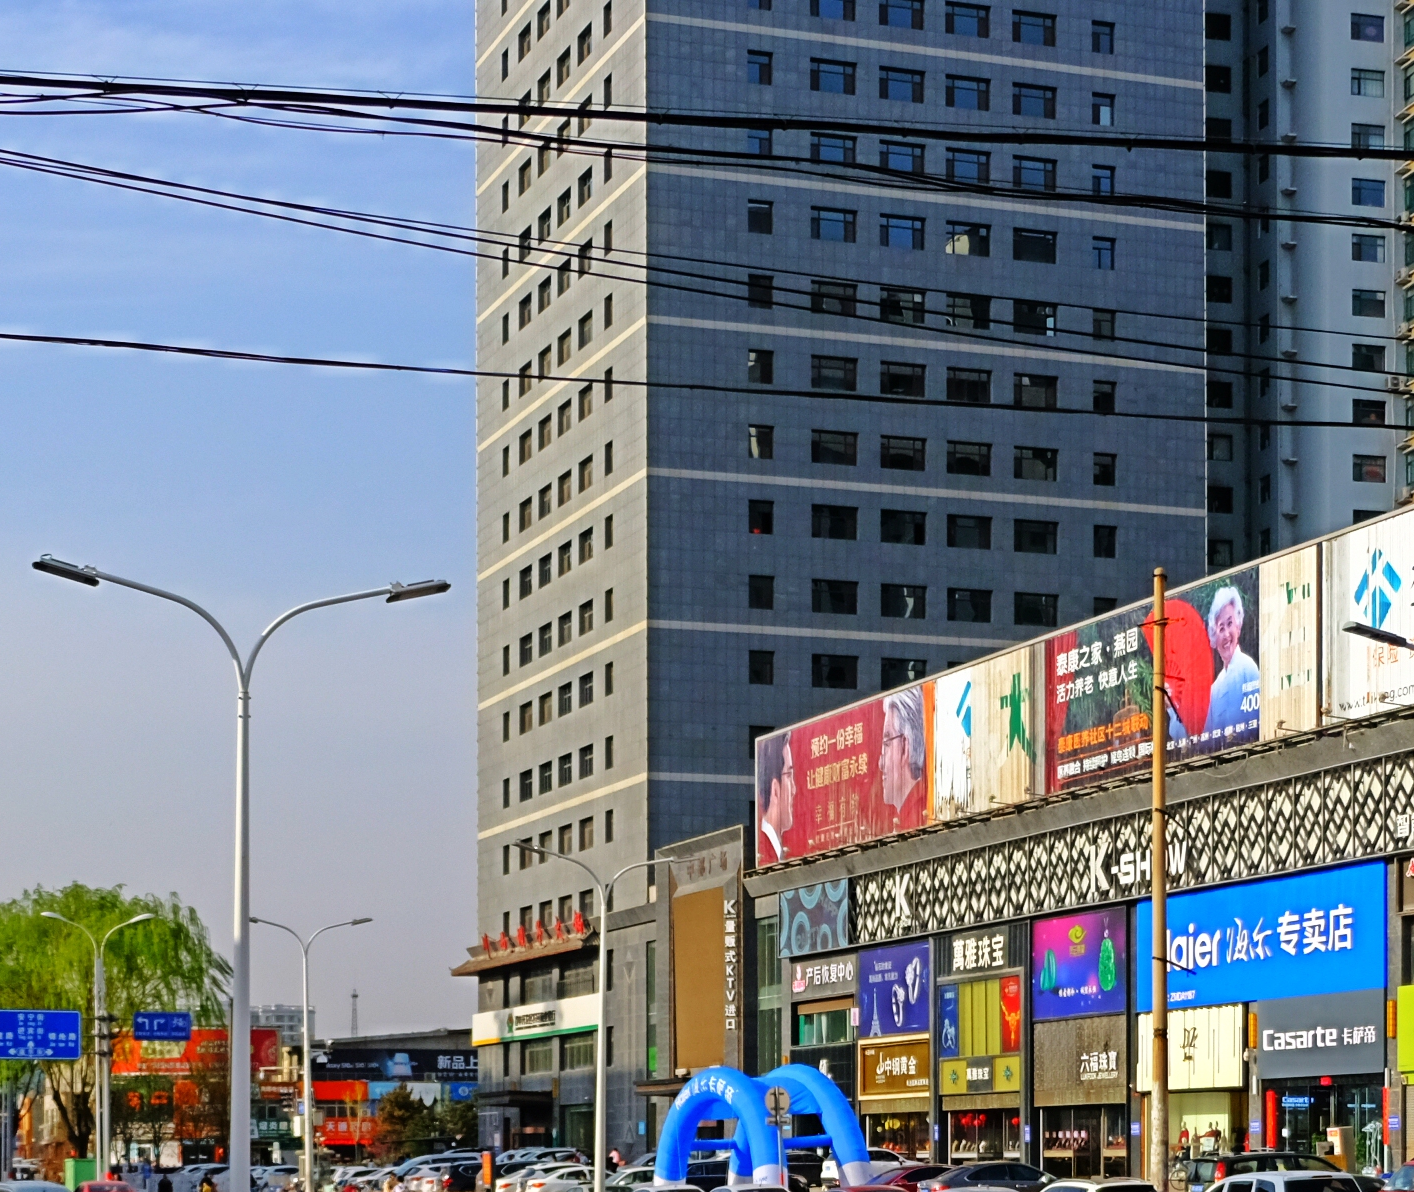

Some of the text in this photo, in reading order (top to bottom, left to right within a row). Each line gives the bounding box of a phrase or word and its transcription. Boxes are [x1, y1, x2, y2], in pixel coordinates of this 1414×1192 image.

[1056, 659, 1139, 704] 活力养老 快意人生
[1240, 692, 1260, 713] 400
[810, 722, 864, 759] 预约一份幸福
[807, 753, 868, 790] 让健康财富永续
[1090, 842, 1187, 892] K-SHW
[953, 933, 1004, 971] 萬雅珠宝
[1166, 922, 1222, 973] aier
[805, 960, 854, 986] 产后恢复中心
[1262, 1025, 1376, 1051] Casarte 卡萨帝
[1080, 1050, 1118, 1073] 六福珠寶
